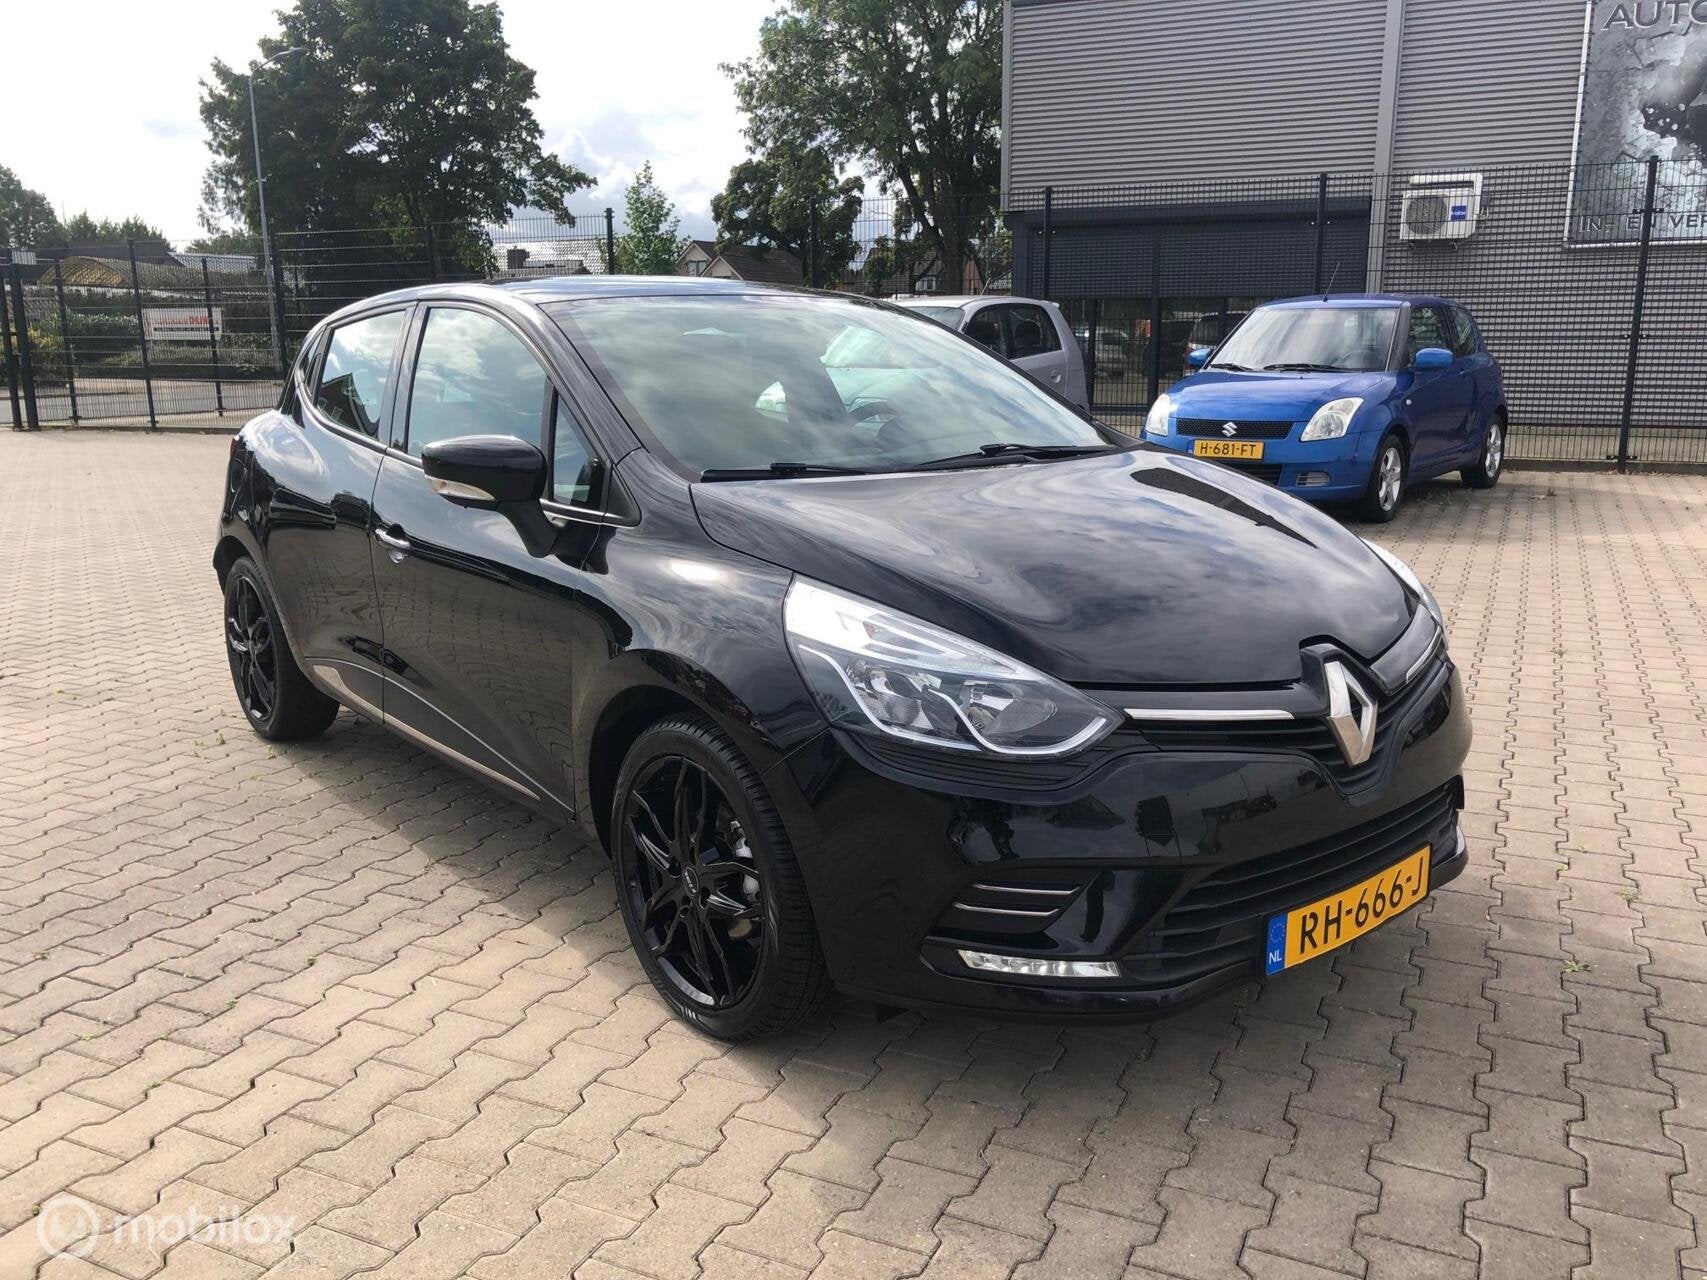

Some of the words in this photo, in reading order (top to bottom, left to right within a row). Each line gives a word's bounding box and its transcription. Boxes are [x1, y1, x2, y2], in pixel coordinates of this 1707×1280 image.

[1200, 442, 1257, 456] H-681-FT
[1268, 951, 1283, 965] NL
[1300, 857, 1424, 954] RH-666-J
